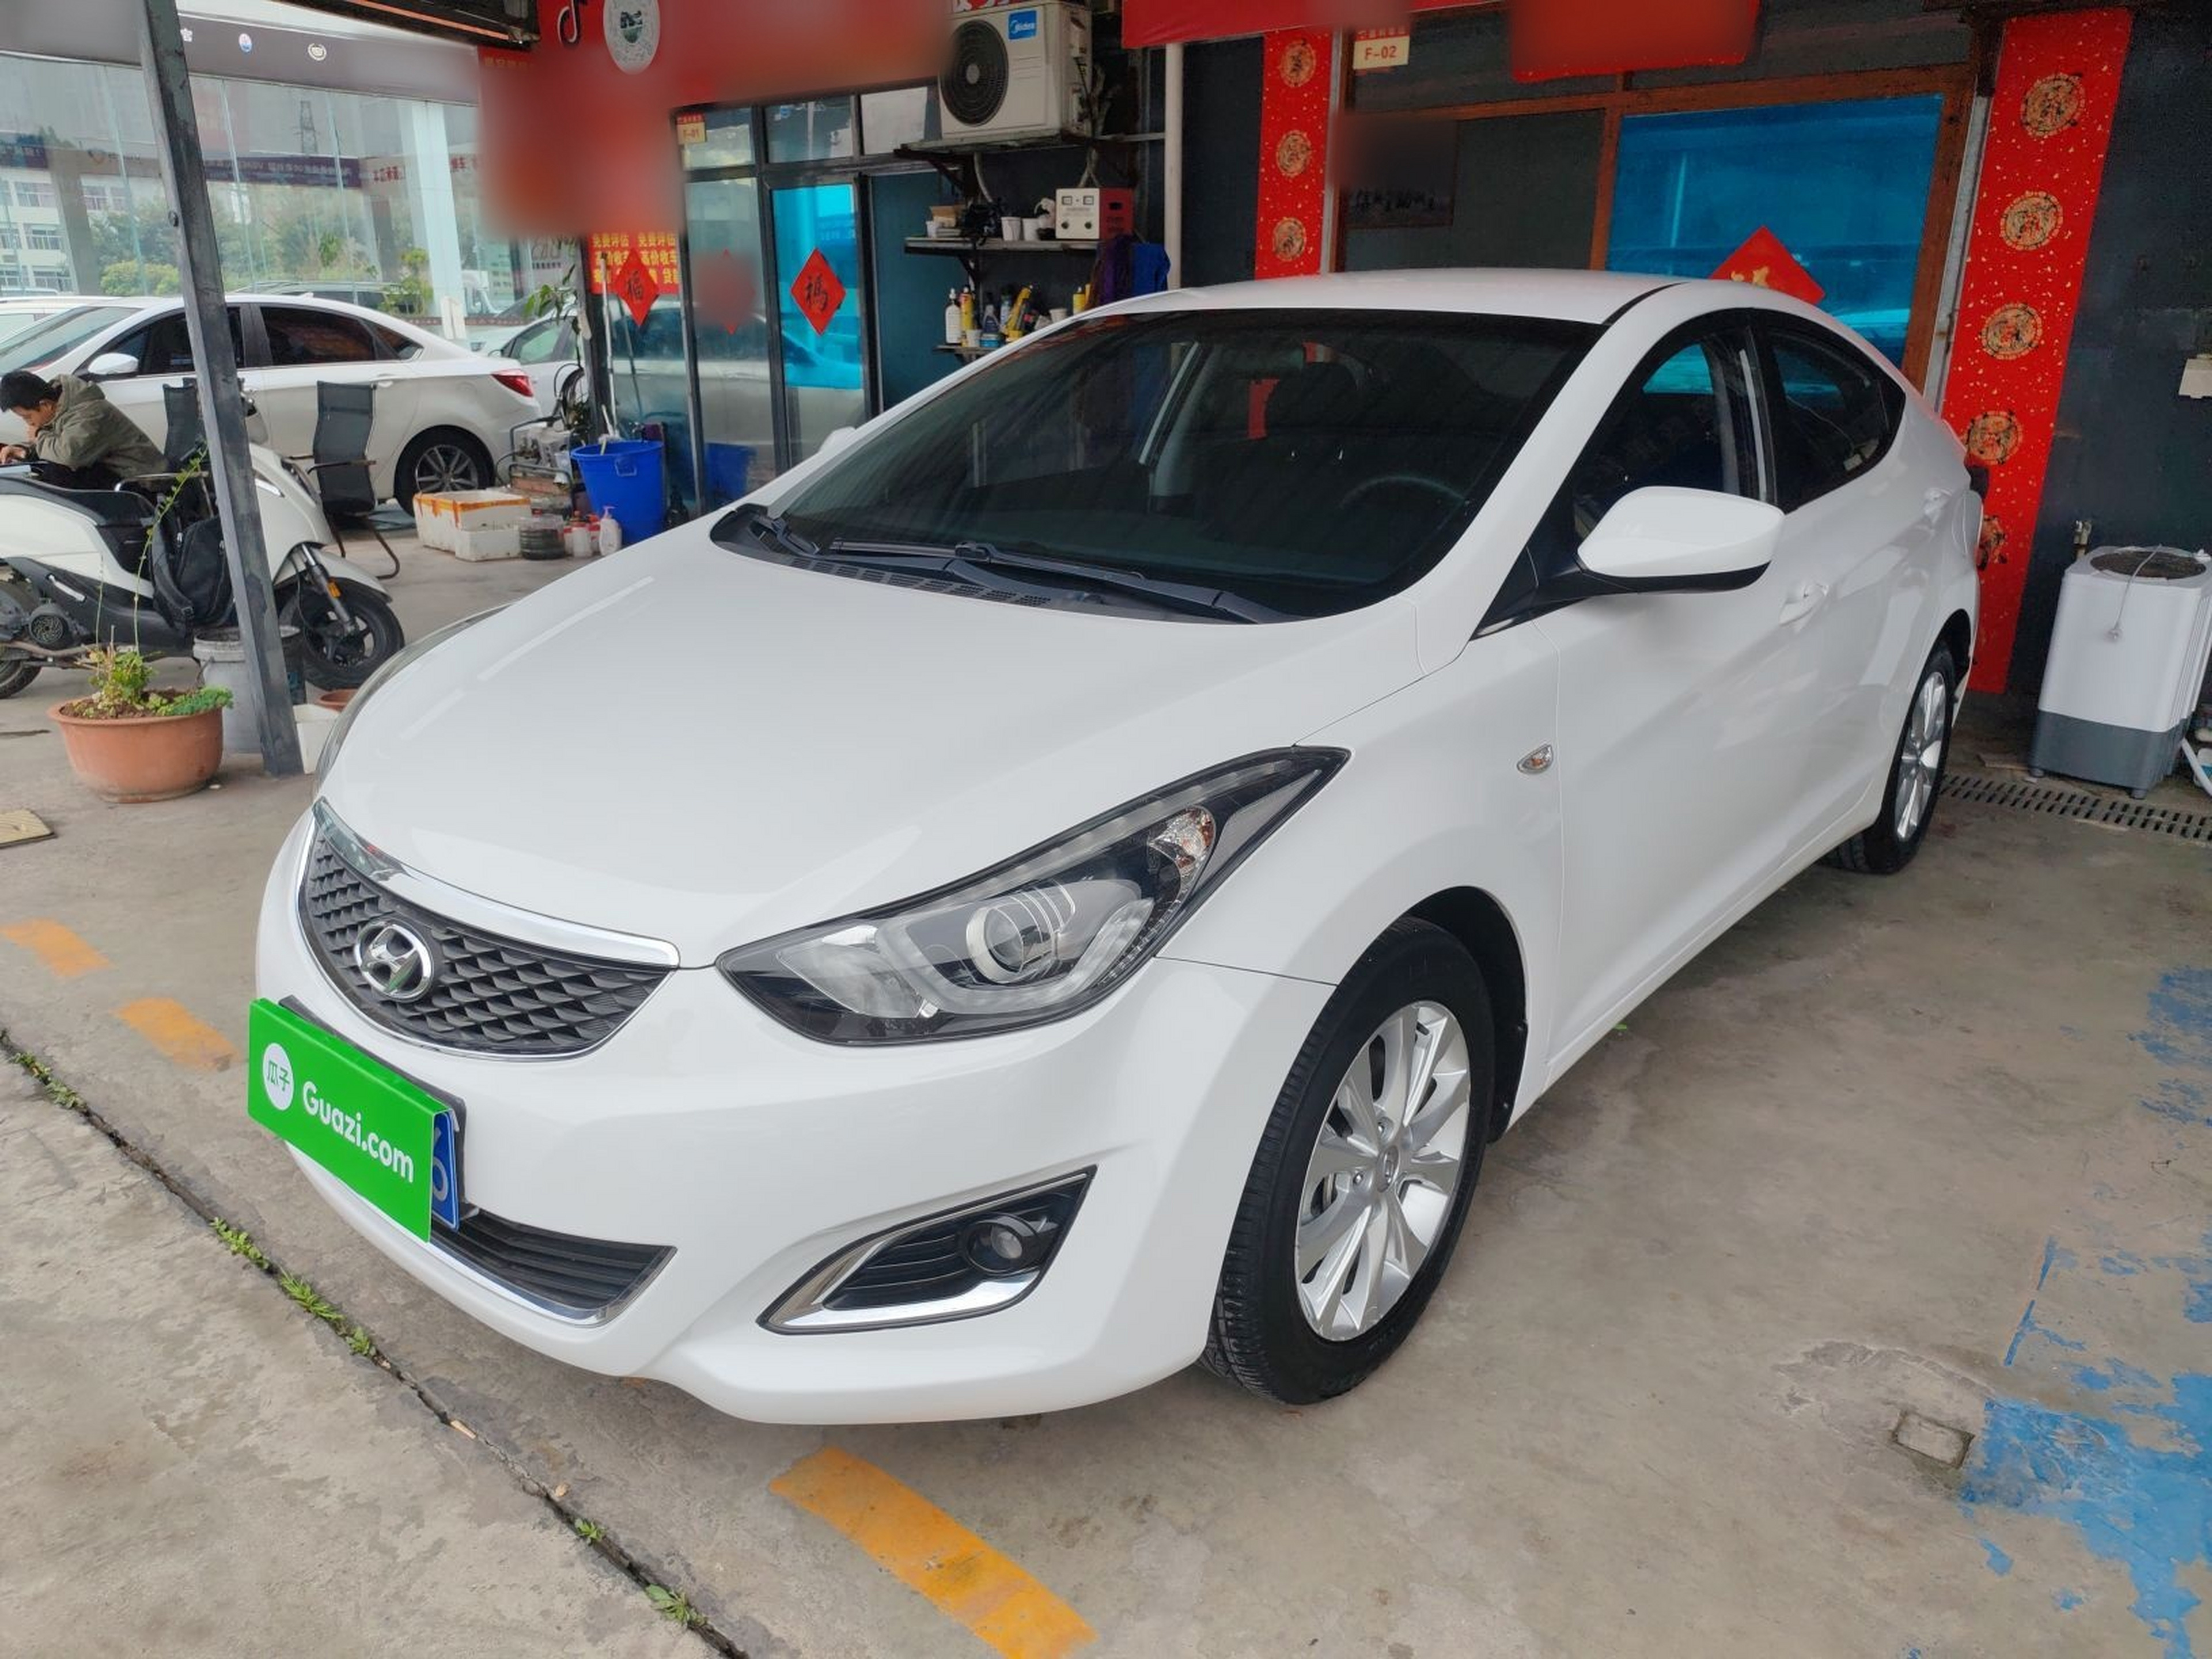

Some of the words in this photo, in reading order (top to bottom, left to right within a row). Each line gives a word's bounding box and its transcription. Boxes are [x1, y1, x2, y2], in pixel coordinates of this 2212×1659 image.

[1365, 46, 1397, 60] F-02
[268, 1060, 290, 1092] 瓜子
[303, 1081, 414, 1183] Guazi.com
